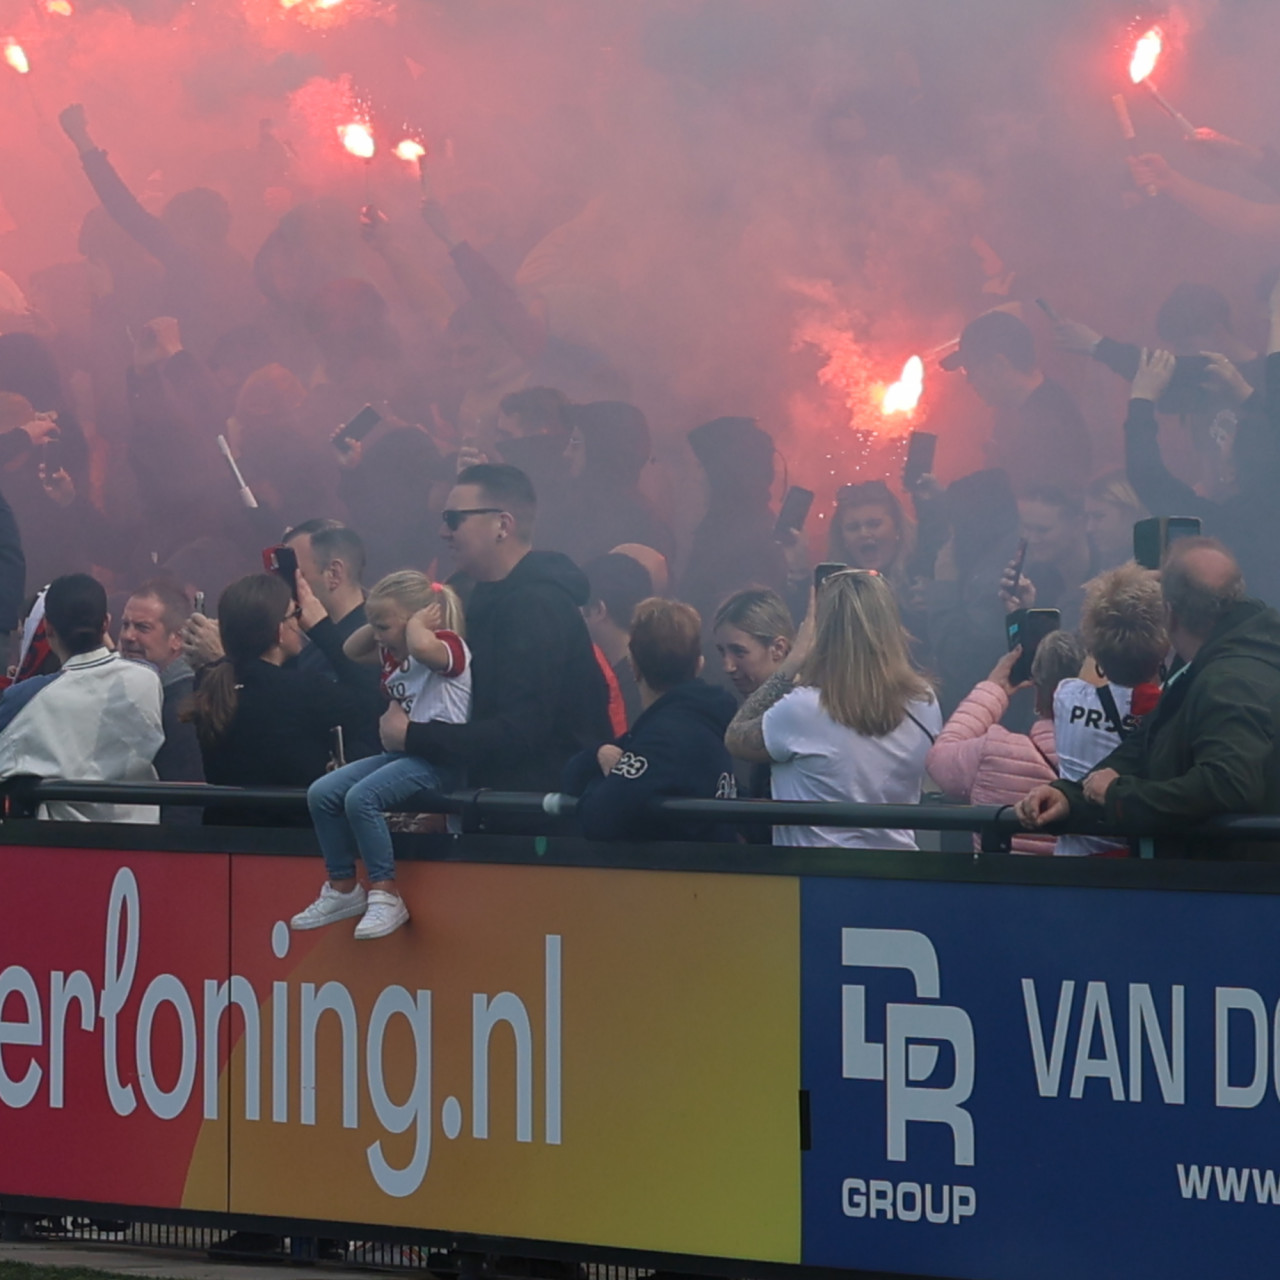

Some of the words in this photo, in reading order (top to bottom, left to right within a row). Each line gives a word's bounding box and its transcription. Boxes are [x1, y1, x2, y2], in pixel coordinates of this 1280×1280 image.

[1021, 978, 1185, 1105] VAN
[1215, 986, 1280, 1109] D
[842, 1177, 976, 1225] GROUP
